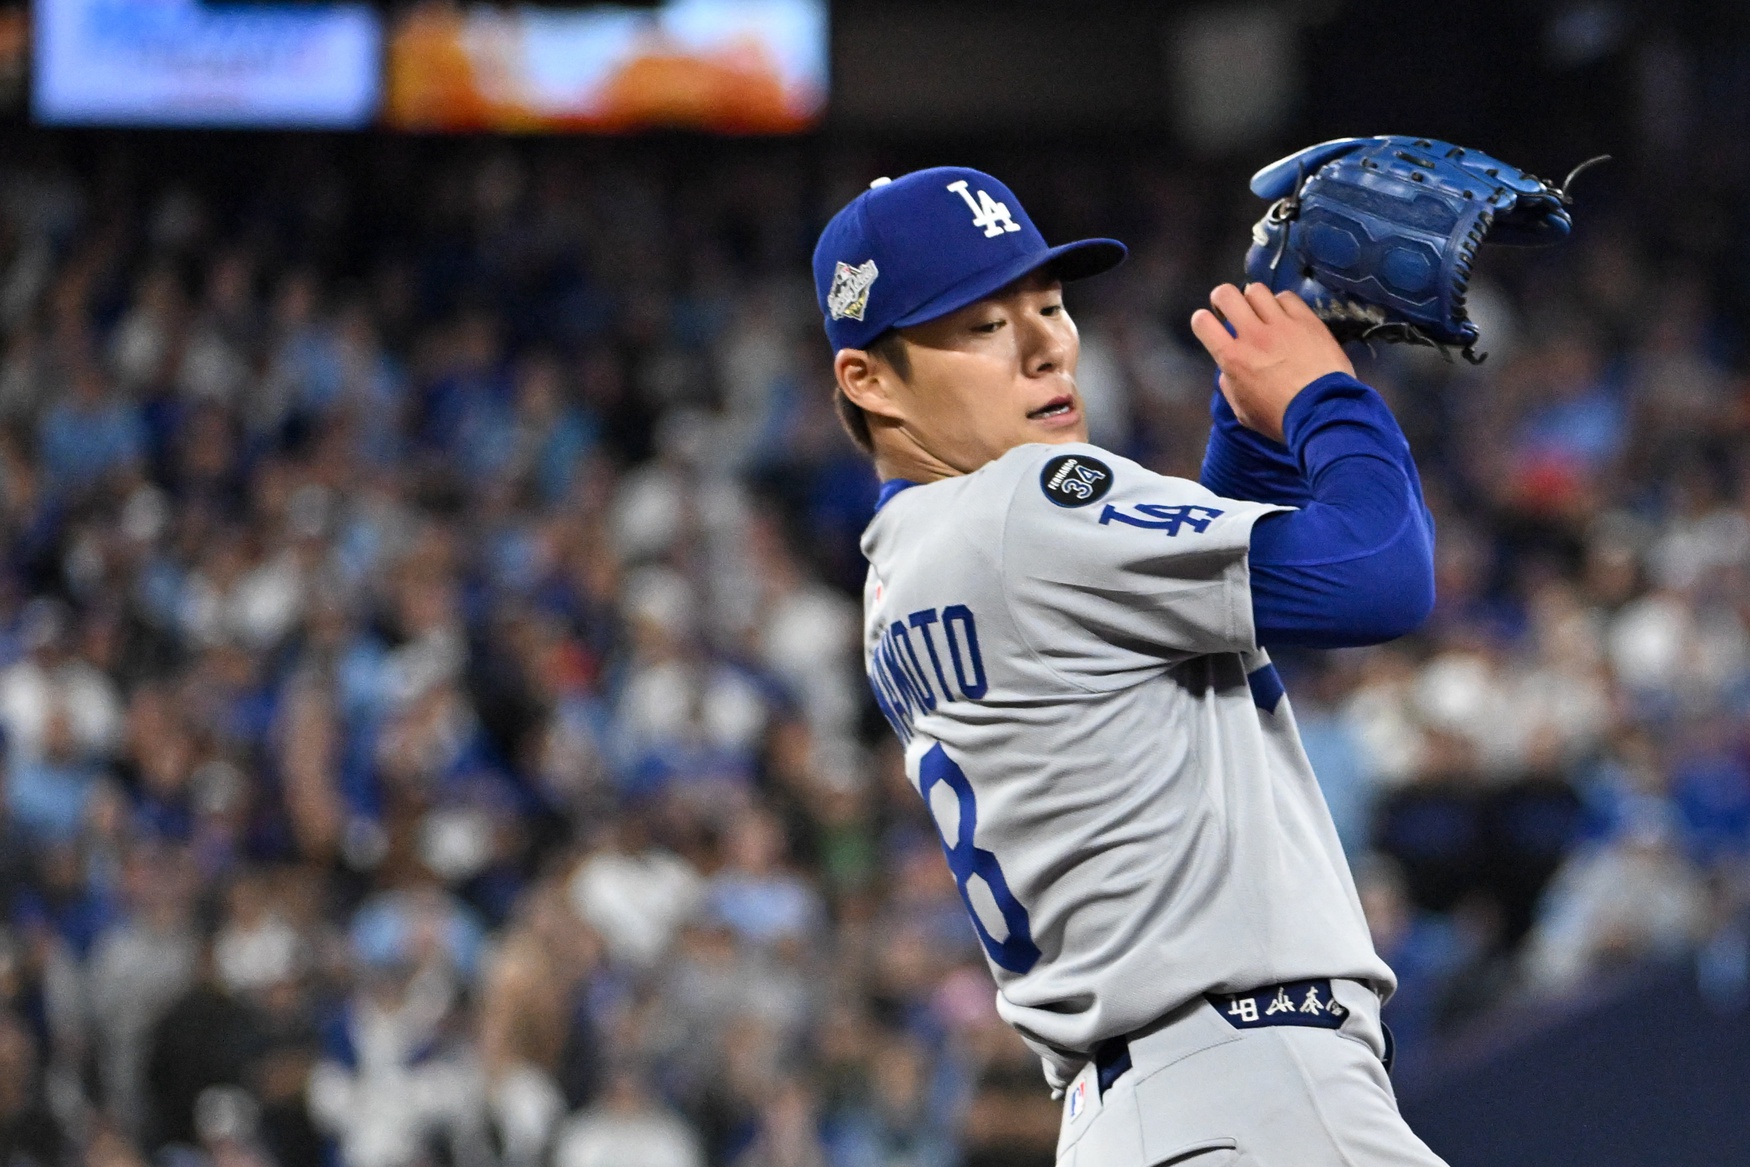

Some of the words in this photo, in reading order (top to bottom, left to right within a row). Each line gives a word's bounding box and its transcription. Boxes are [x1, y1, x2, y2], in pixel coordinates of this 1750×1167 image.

[946, 180, 1021, 238] LA
[1061, 464, 1106, 500] 34
[1098, 503, 1225, 537] LA
